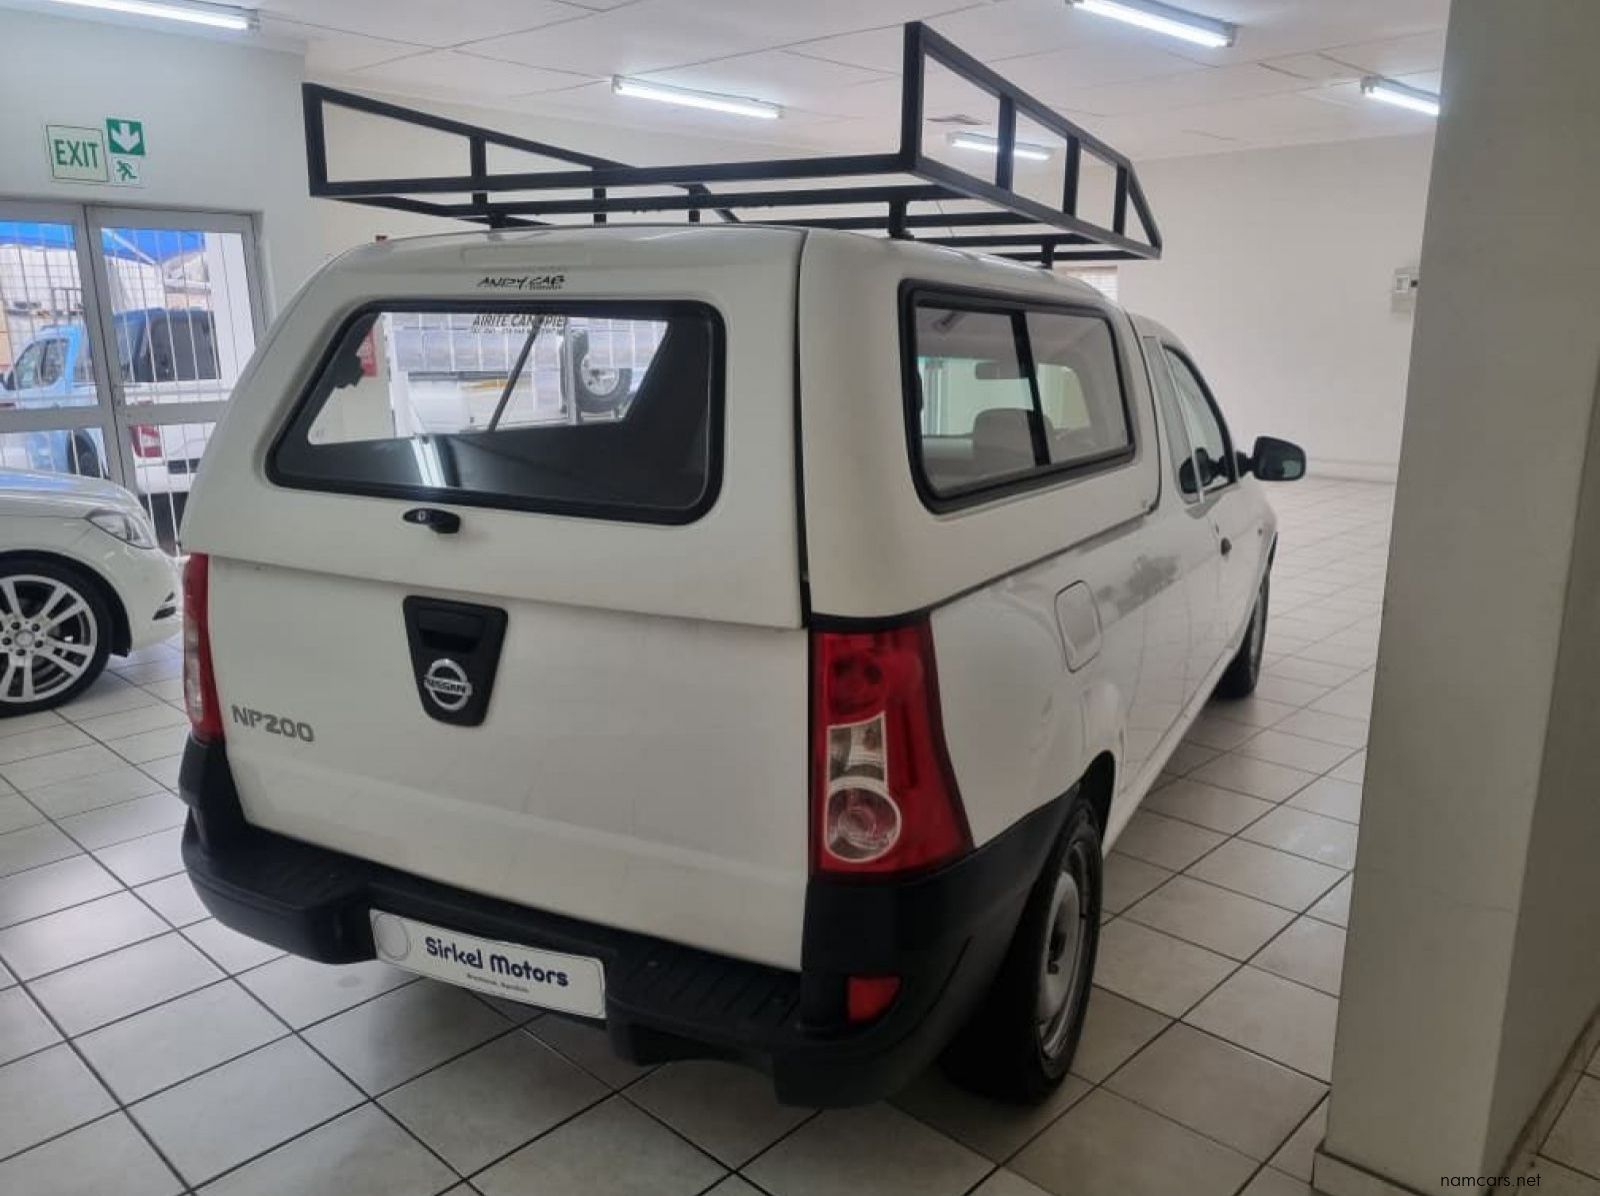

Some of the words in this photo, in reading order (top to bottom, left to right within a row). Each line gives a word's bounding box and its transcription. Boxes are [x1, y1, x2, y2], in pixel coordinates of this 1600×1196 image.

[54, 139, 98, 169] EXIT
[477, 276, 529, 290] ANDY
[231, 704, 315, 742] NP200
[425, 936, 483, 969] Sirkel
[489, 954, 569, 987] Motors
